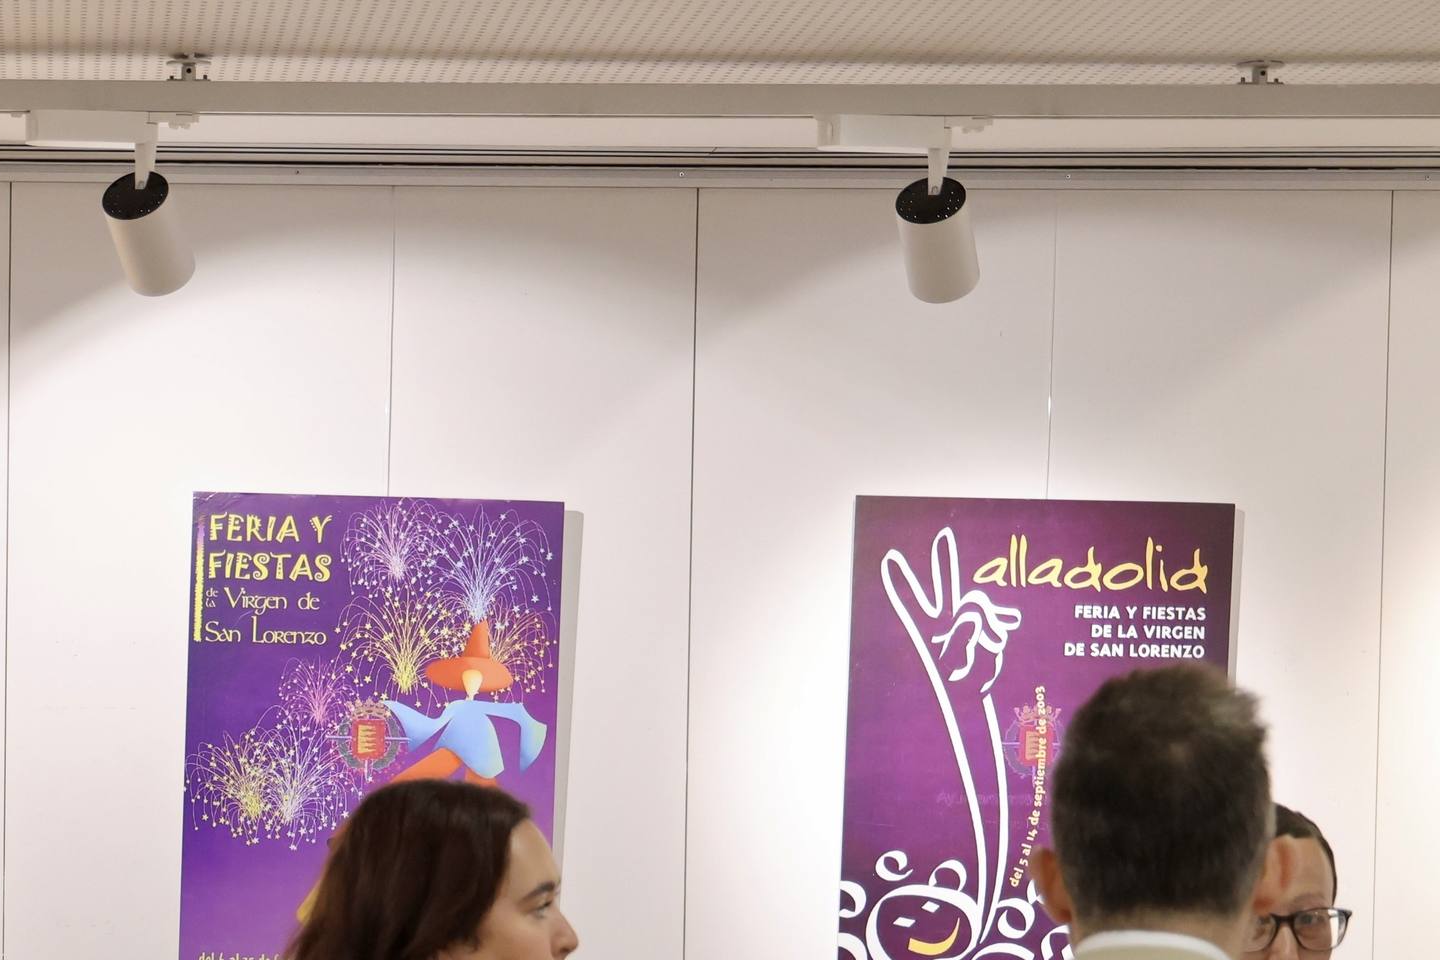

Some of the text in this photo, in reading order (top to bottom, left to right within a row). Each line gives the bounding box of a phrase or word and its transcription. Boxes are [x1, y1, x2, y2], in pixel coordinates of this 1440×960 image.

[209, 512, 333, 543] FERIA Y
[208, 549, 332, 582] FIESTAS
[205, 588, 219, 597] de
[224, 587, 320, 615] Virgen de
[1074, 605, 1207, 621] FERIA Y FIESTAS
[205, 615, 327, 645] San Lorenzo
[1091, 624, 1205, 640] DE LA VIRGEN
[1064, 642, 1205, 659] DE SAN LORENZO
[1009, 686, 1047, 887] del 5 al 14 de septiembre de 2003
